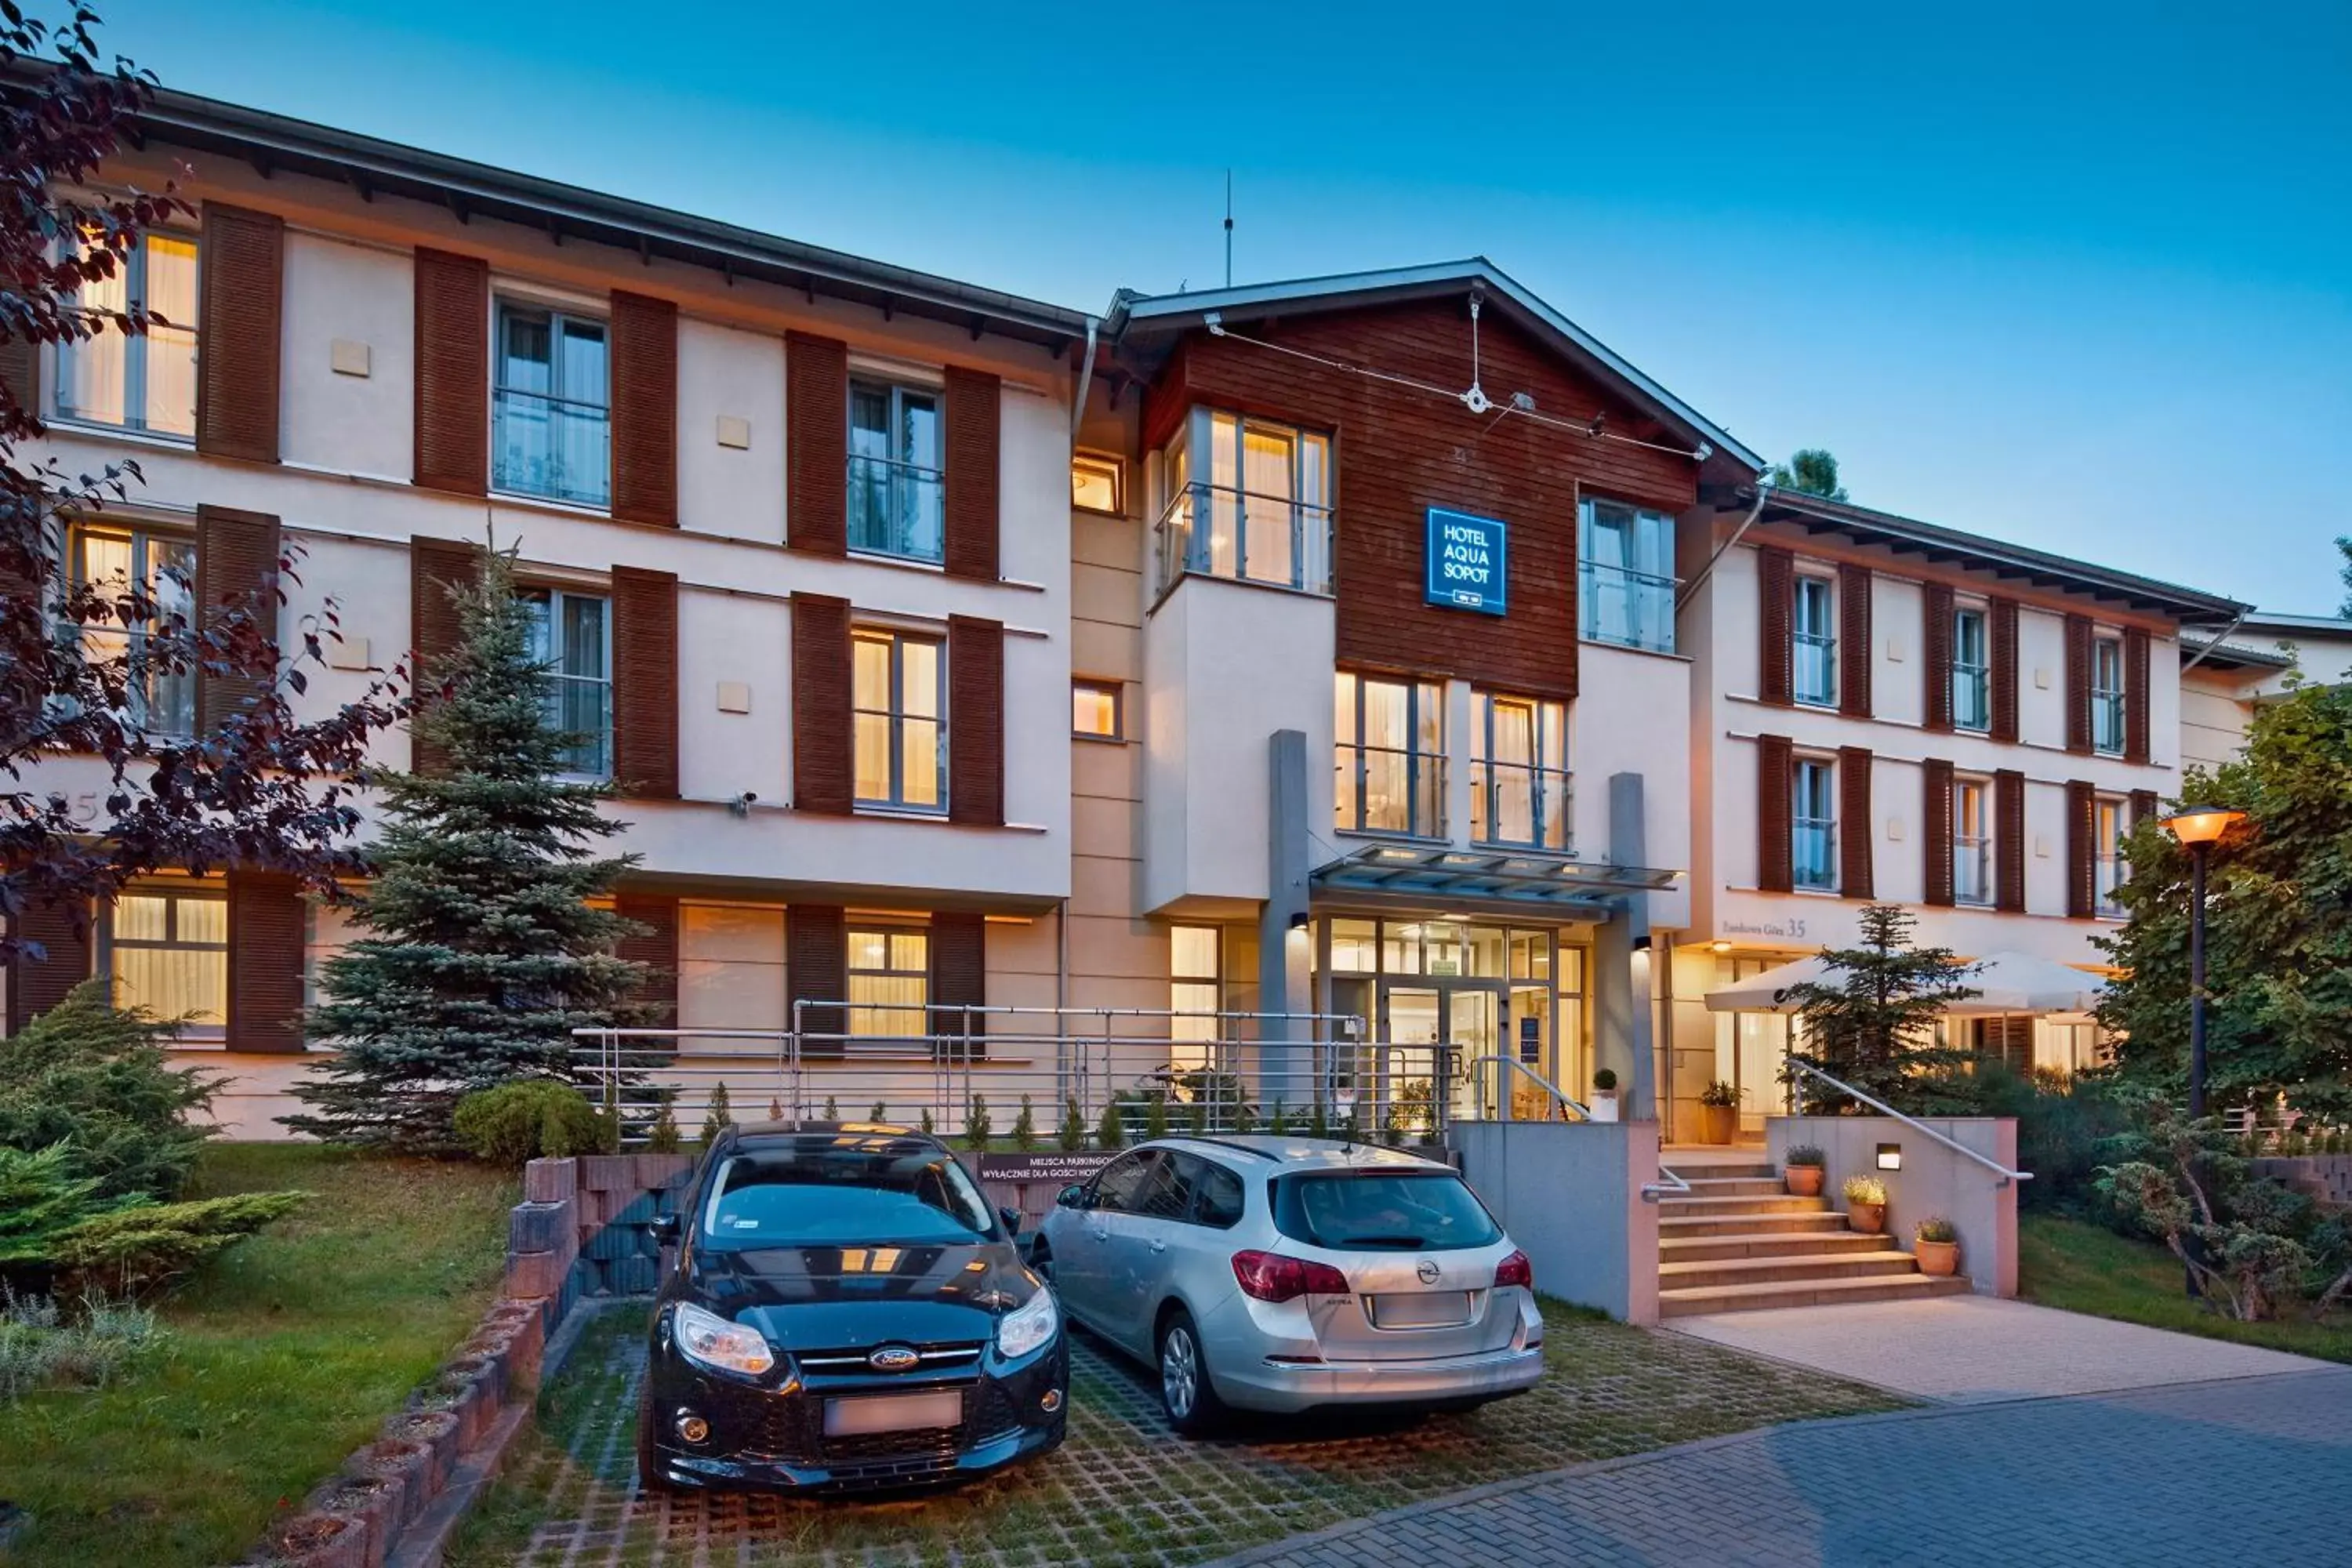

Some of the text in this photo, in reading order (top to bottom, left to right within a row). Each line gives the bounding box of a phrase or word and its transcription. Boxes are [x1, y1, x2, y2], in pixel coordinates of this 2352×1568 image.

[1444, 524, 1489, 546] HOTEL
[1444, 544, 1489, 565] AQUA
[1444, 562, 1490, 583] SOPOT
[1788, 918, 1806, 938] 35
[1029, 1157, 1065, 1166] MIEJSCA
[982, 1169, 1030, 1179] WYŁĄCZNIE
[1033, 1169, 1048, 1178] DLA
